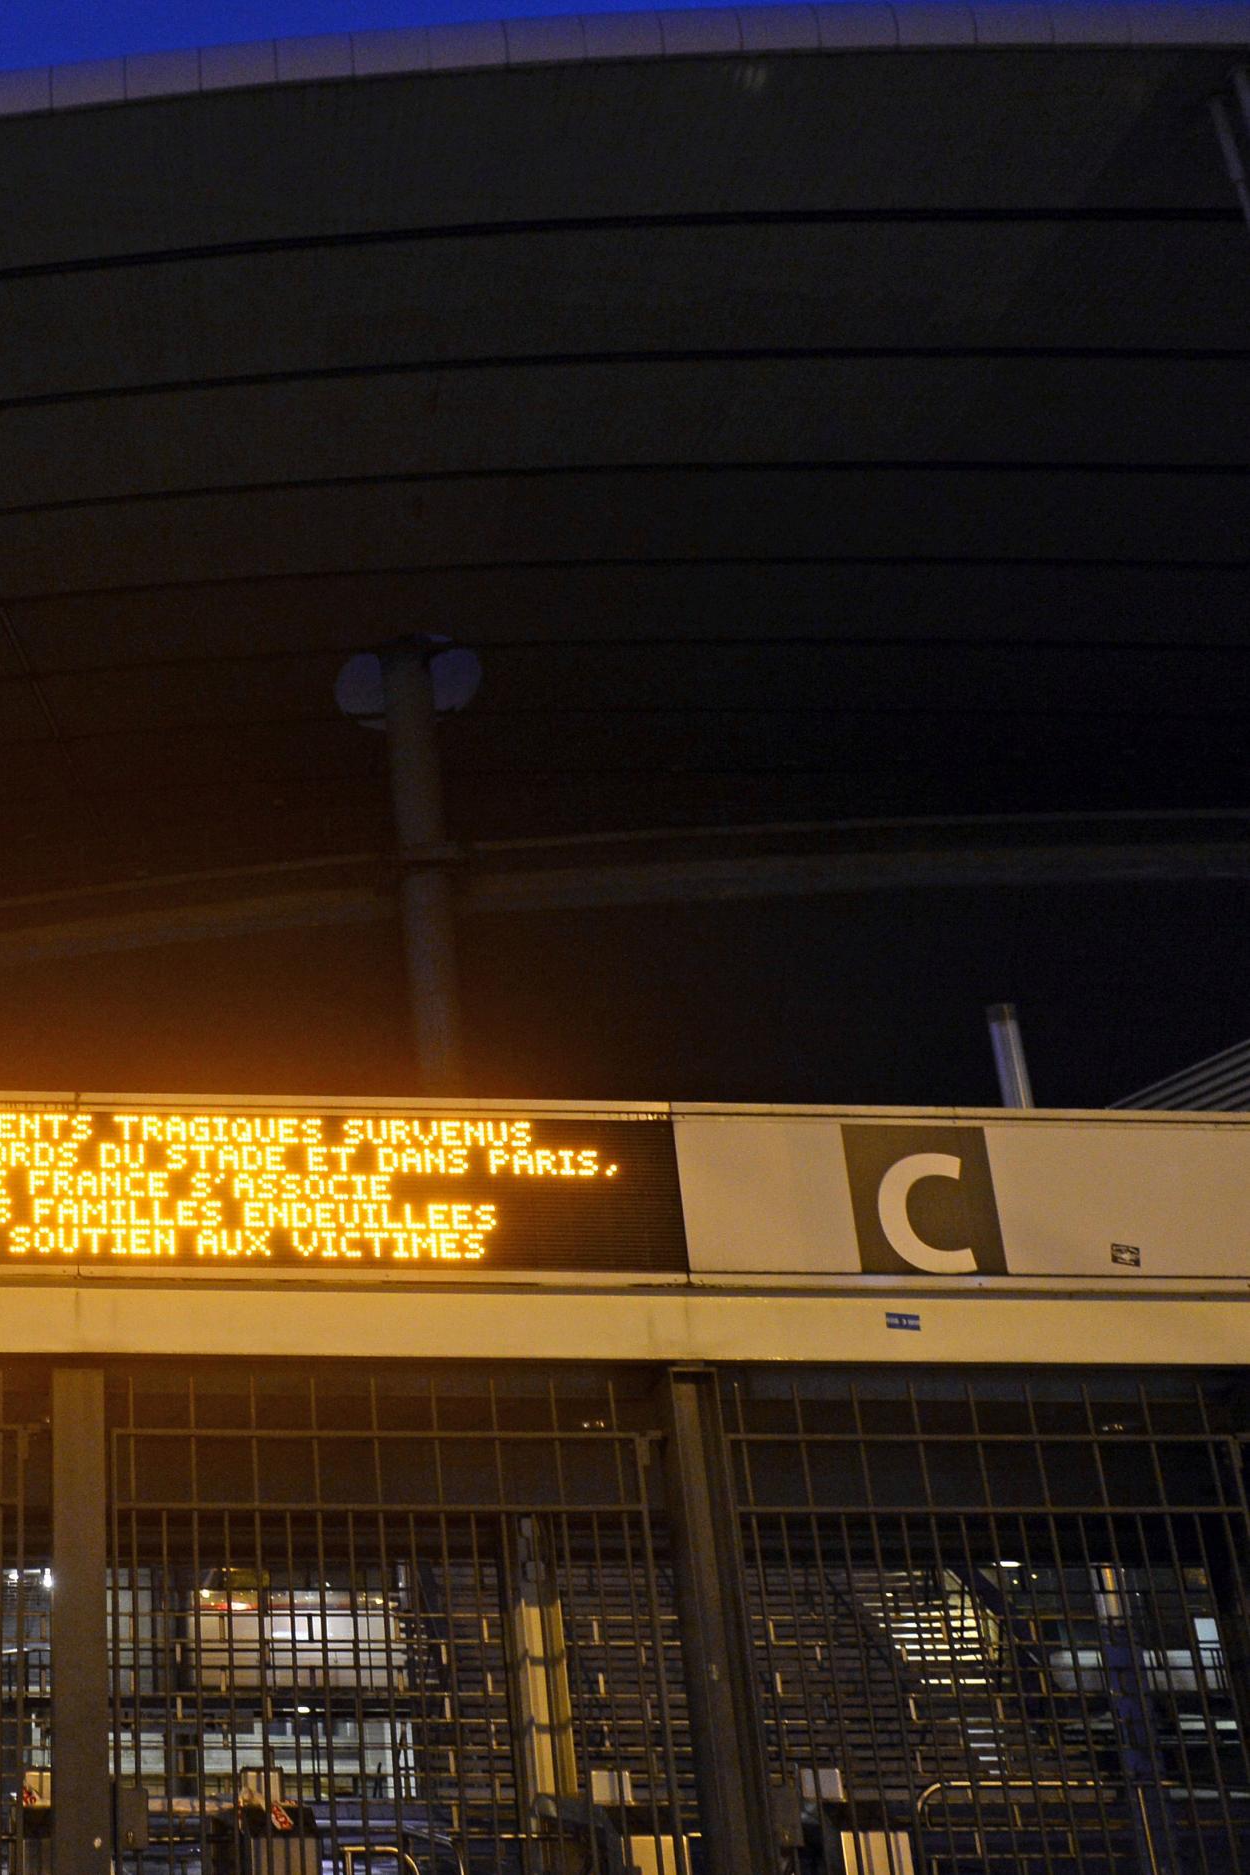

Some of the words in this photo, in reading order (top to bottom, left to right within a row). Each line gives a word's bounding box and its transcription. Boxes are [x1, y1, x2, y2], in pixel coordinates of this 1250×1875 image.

[113, 1114, 323, 1144] TRAGIQUES
[343, 1119, 532, 1147] SURVENUS
[99, 1142, 145, 1169] DU
[165, 1142, 287, 1172] STADE
[306, 1145, 357, 1173] ET
[377, 1146, 469, 1174] DANS
[488, 1149, 618, 1177] PARIS,
[28, 1169, 170, 1199] FRANCE
[190, 1170, 392, 1202] S'ASSOCIE
[32, 1197, 223, 1228] FAMILLES
[243, 1200, 497, 1232] ENDEUILLEES
[878, 1152, 978, 1274] C
[9, 1224, 176, 1256] SOUTIEN
[196, 1228, 272, 1256] AUX
[291, 1229, 485, 1260] VICTIMES
